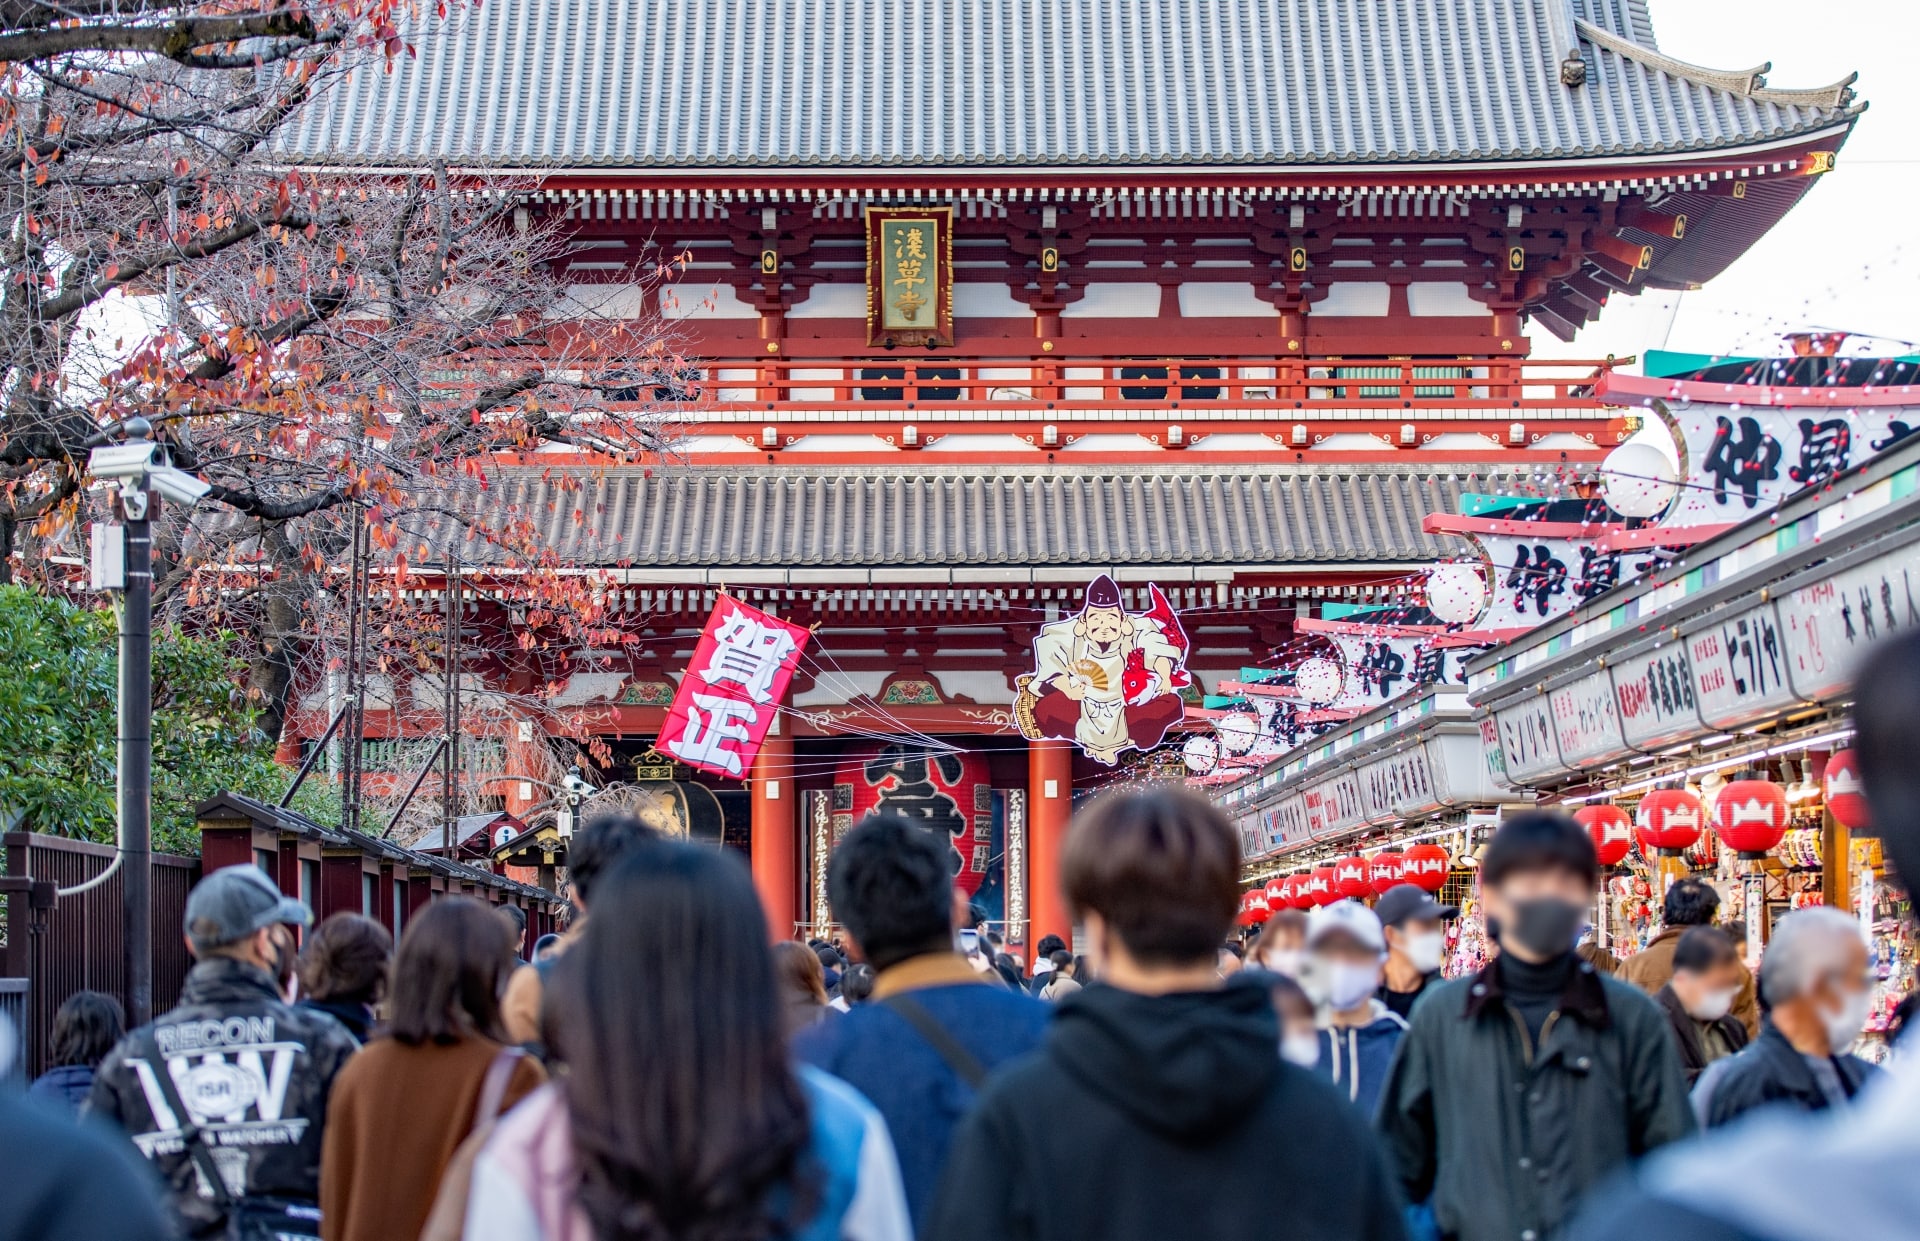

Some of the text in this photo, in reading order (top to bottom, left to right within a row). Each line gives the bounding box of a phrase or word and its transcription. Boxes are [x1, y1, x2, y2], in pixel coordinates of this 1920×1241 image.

[1723, 615, 1781, 696] ヒラノヤ
[669, 606, 796, 775] 賀正
[1504, 708, 1550, 766] ミノリヤ
[155, 1016, 275, 1053] RECON
